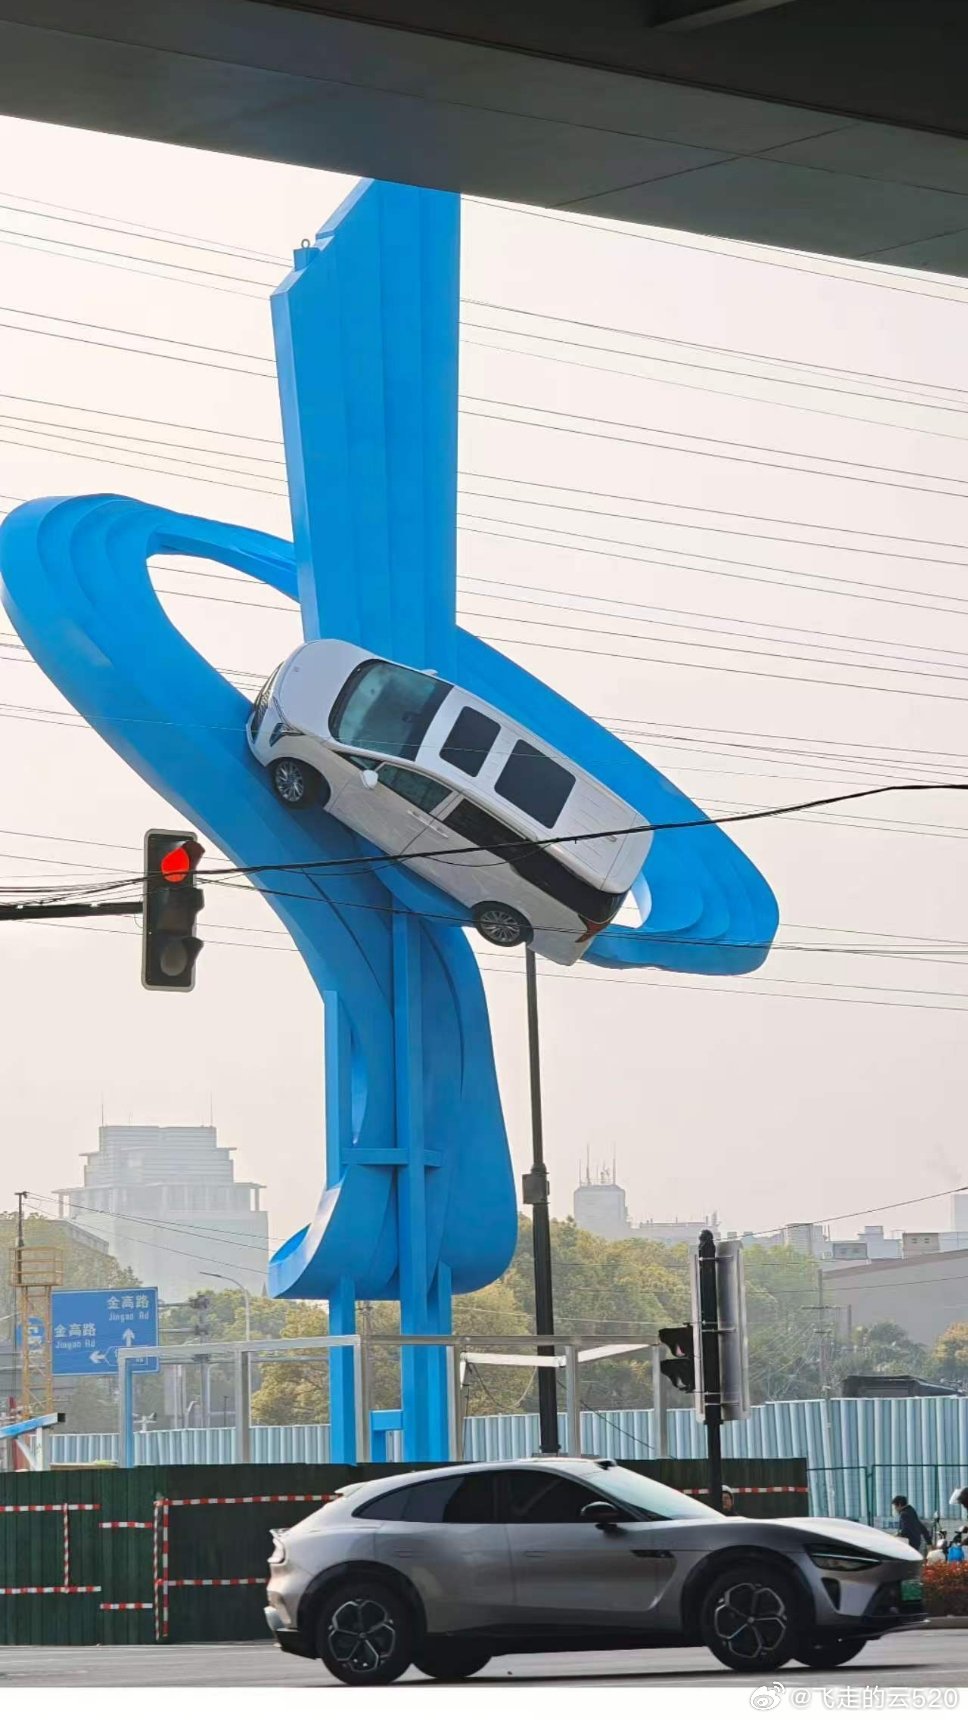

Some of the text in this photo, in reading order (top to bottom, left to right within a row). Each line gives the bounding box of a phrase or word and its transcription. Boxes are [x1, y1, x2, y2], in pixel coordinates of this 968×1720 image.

[107, 1295, 149, 1310] 金高路
[139, 1311, 149, 1320] Rd
[54, 1322, 96, 1338] 金高路
[85, 1339, 96, 1348] Rd
